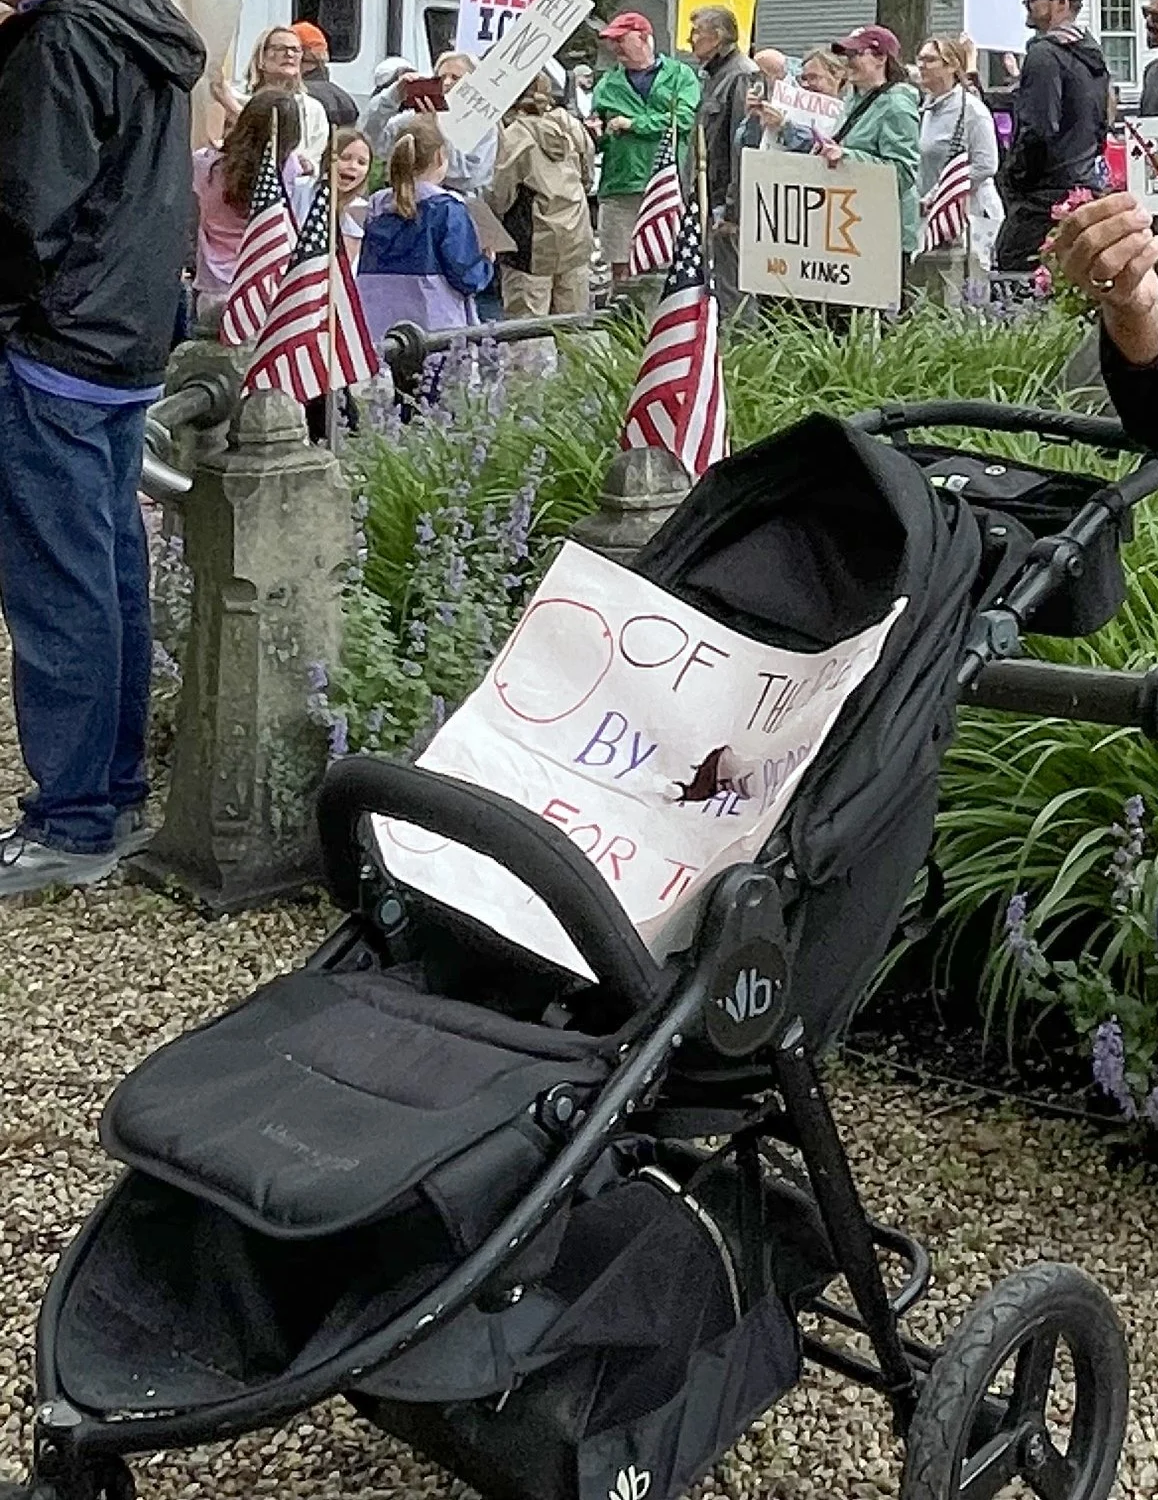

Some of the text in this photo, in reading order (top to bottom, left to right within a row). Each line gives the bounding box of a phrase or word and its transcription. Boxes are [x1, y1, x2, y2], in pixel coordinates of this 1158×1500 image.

[477, 6, 523, 42] IC
[499, 21, 552, 72] NO
[756, 182, 862, 258] NOPE
[799, 258, 852, 286] KINGS
[619, 614, 731, 693] OF
[573, 710, 659, 781] BY
